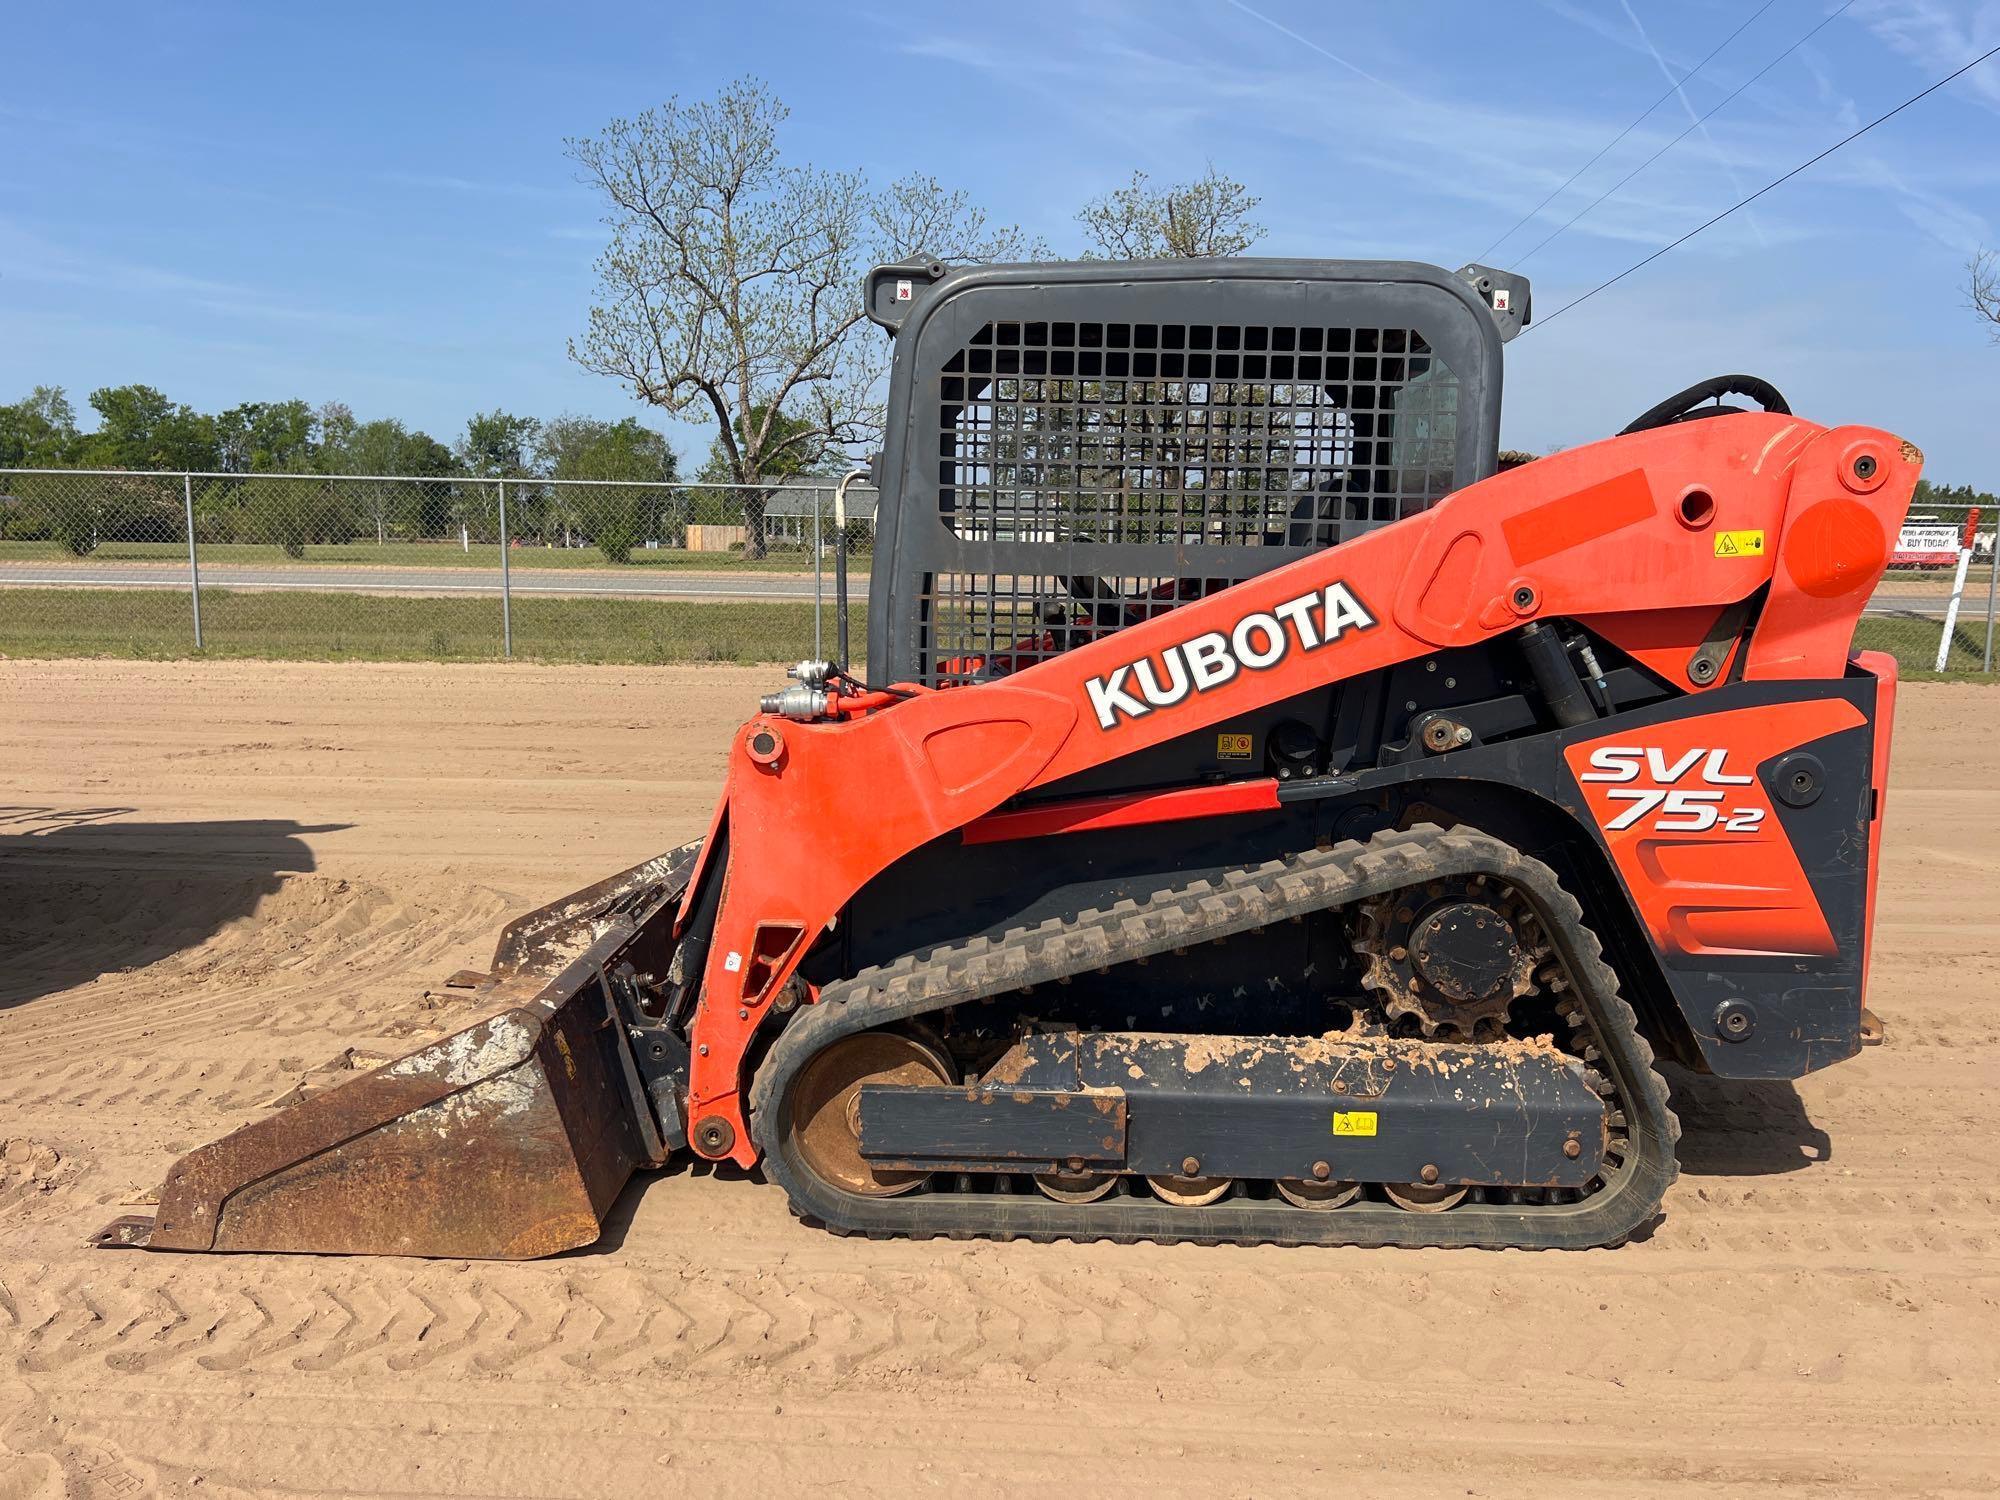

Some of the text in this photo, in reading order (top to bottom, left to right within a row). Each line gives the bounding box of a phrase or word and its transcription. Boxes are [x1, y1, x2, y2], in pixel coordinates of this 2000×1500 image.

[1907, 539, 1922, 548] BUY
[1084, 581, 1377, 730] KUBOTA
[1580, 747, 1754, 785] SVL
[1603, 788, 1766, 832] 75-2
